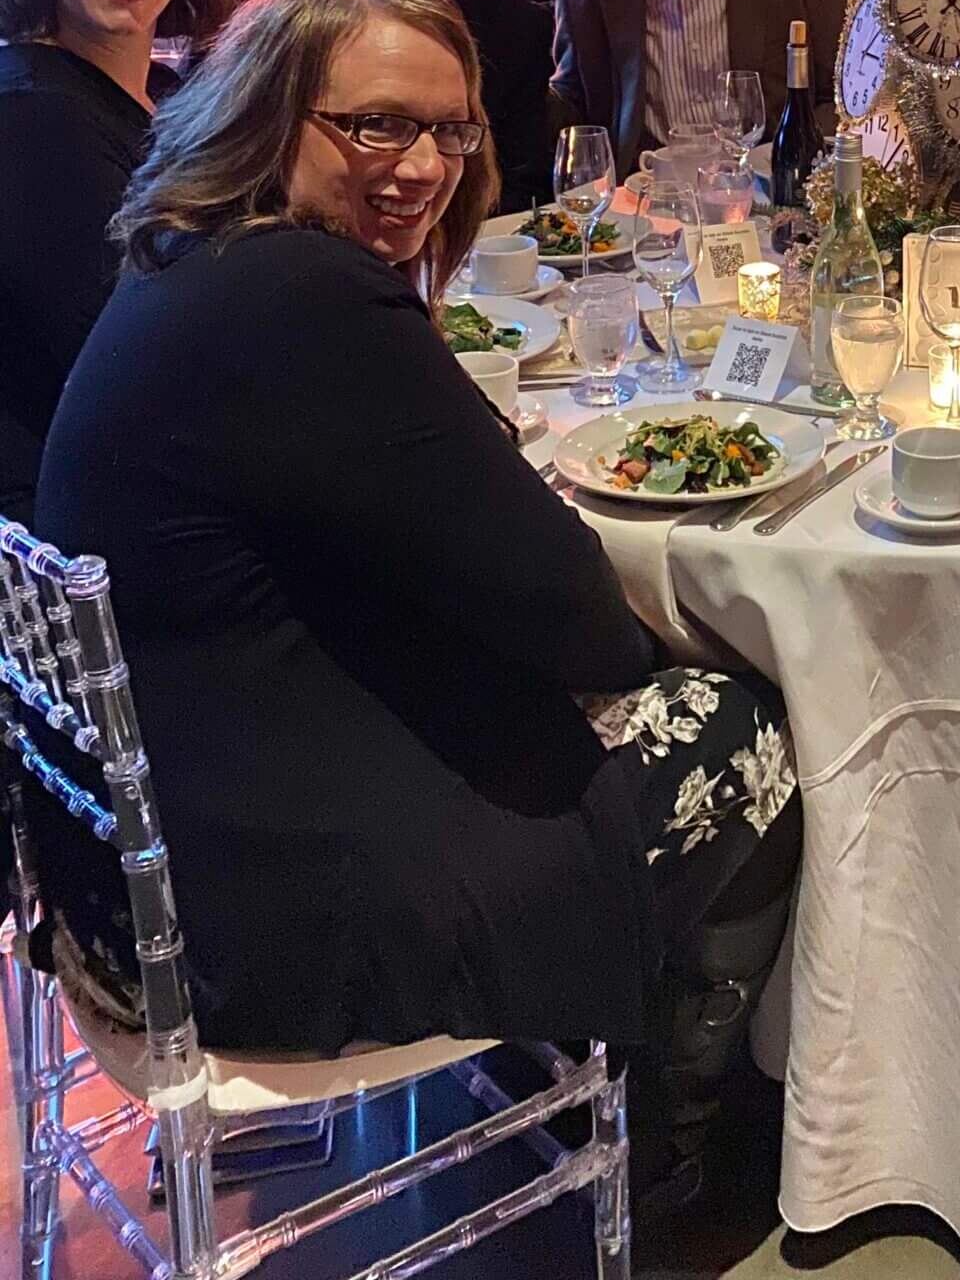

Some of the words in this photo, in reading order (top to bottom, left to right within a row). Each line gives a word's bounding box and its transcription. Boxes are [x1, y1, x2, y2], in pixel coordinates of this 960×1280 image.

[852, 91, 859, 107] 6
[862, 89, 869, 105] 5
[946, 100, 959, 120] 8
[877, 114, 889, 133] 12
[893, 123, 899, 143] 1
[944, 286, 960, 309] 1
